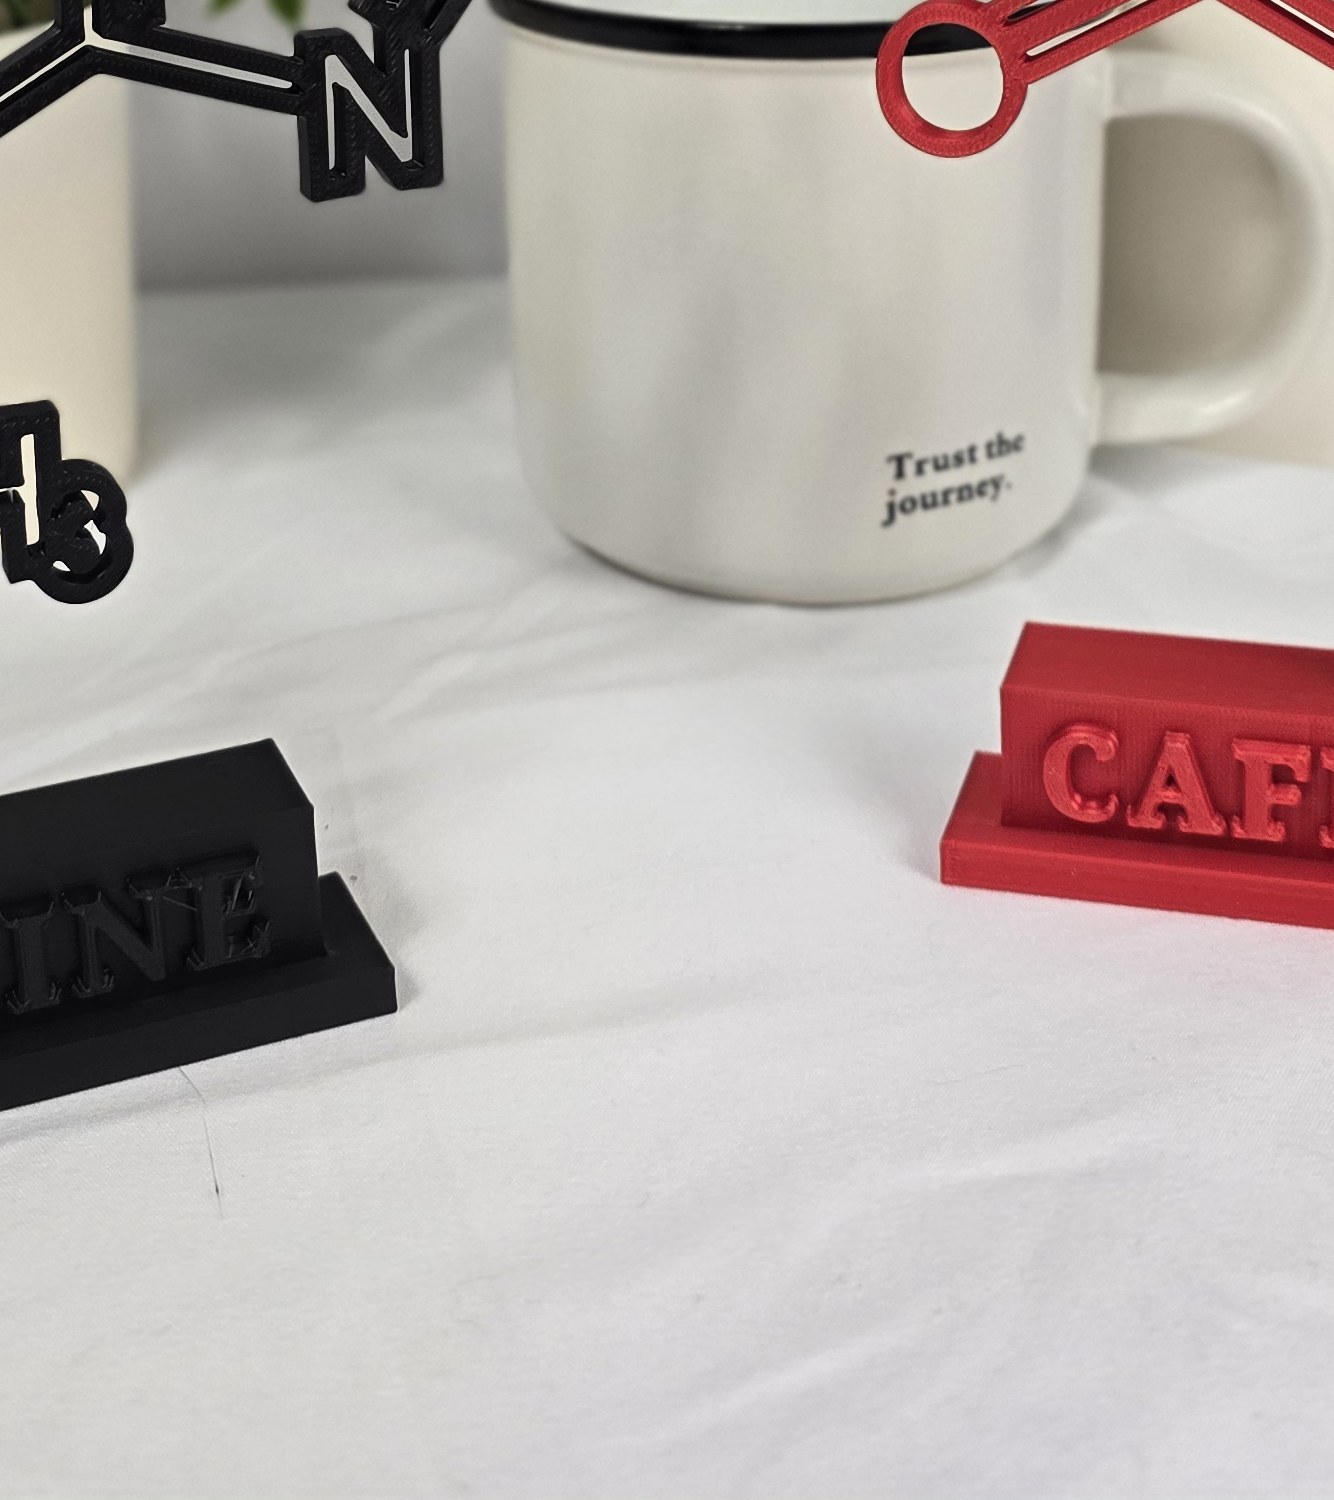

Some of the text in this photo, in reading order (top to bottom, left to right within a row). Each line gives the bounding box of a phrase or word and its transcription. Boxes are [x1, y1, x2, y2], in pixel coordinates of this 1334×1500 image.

[294, 28, 444, 203] N
[886, 431, 1025, 481] Trust the
[880, 472, 1013, 529] journey.
